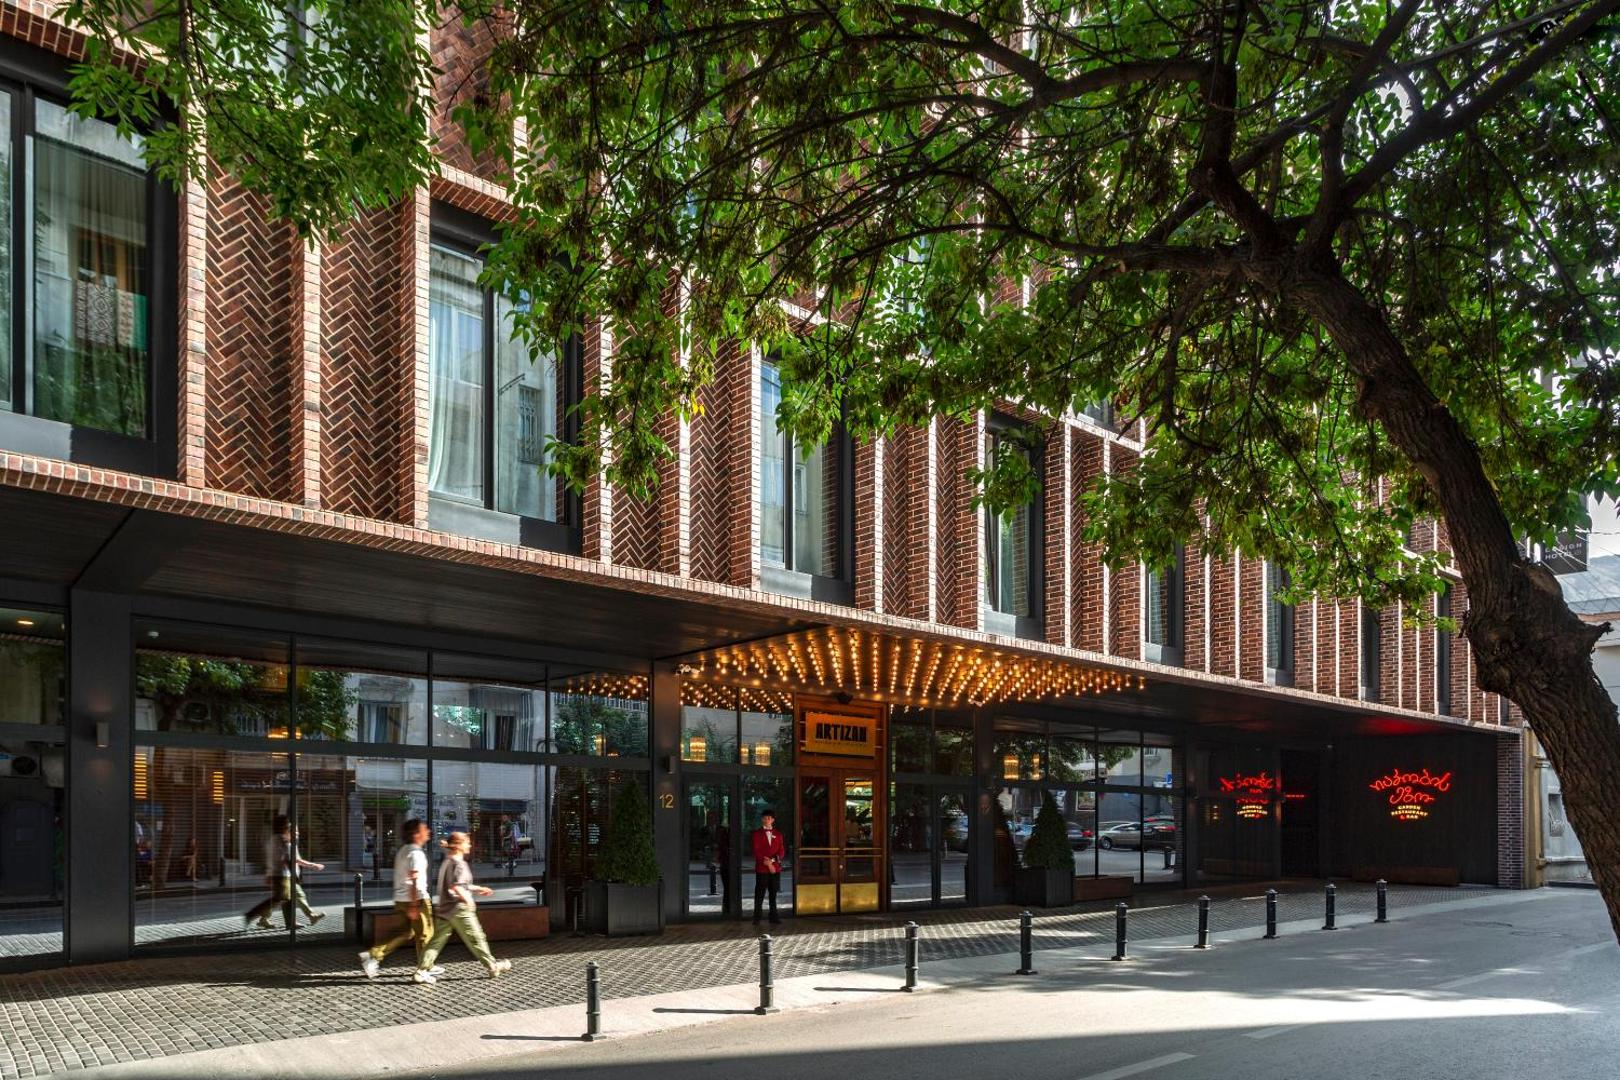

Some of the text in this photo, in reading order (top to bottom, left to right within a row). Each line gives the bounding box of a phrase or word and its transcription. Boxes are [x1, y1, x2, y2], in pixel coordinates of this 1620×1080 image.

[816, 723, 867, 742] ARTIZAN
[659, 794, 674, 809] 12
[1389, 786, 1434, 805] ეზო
